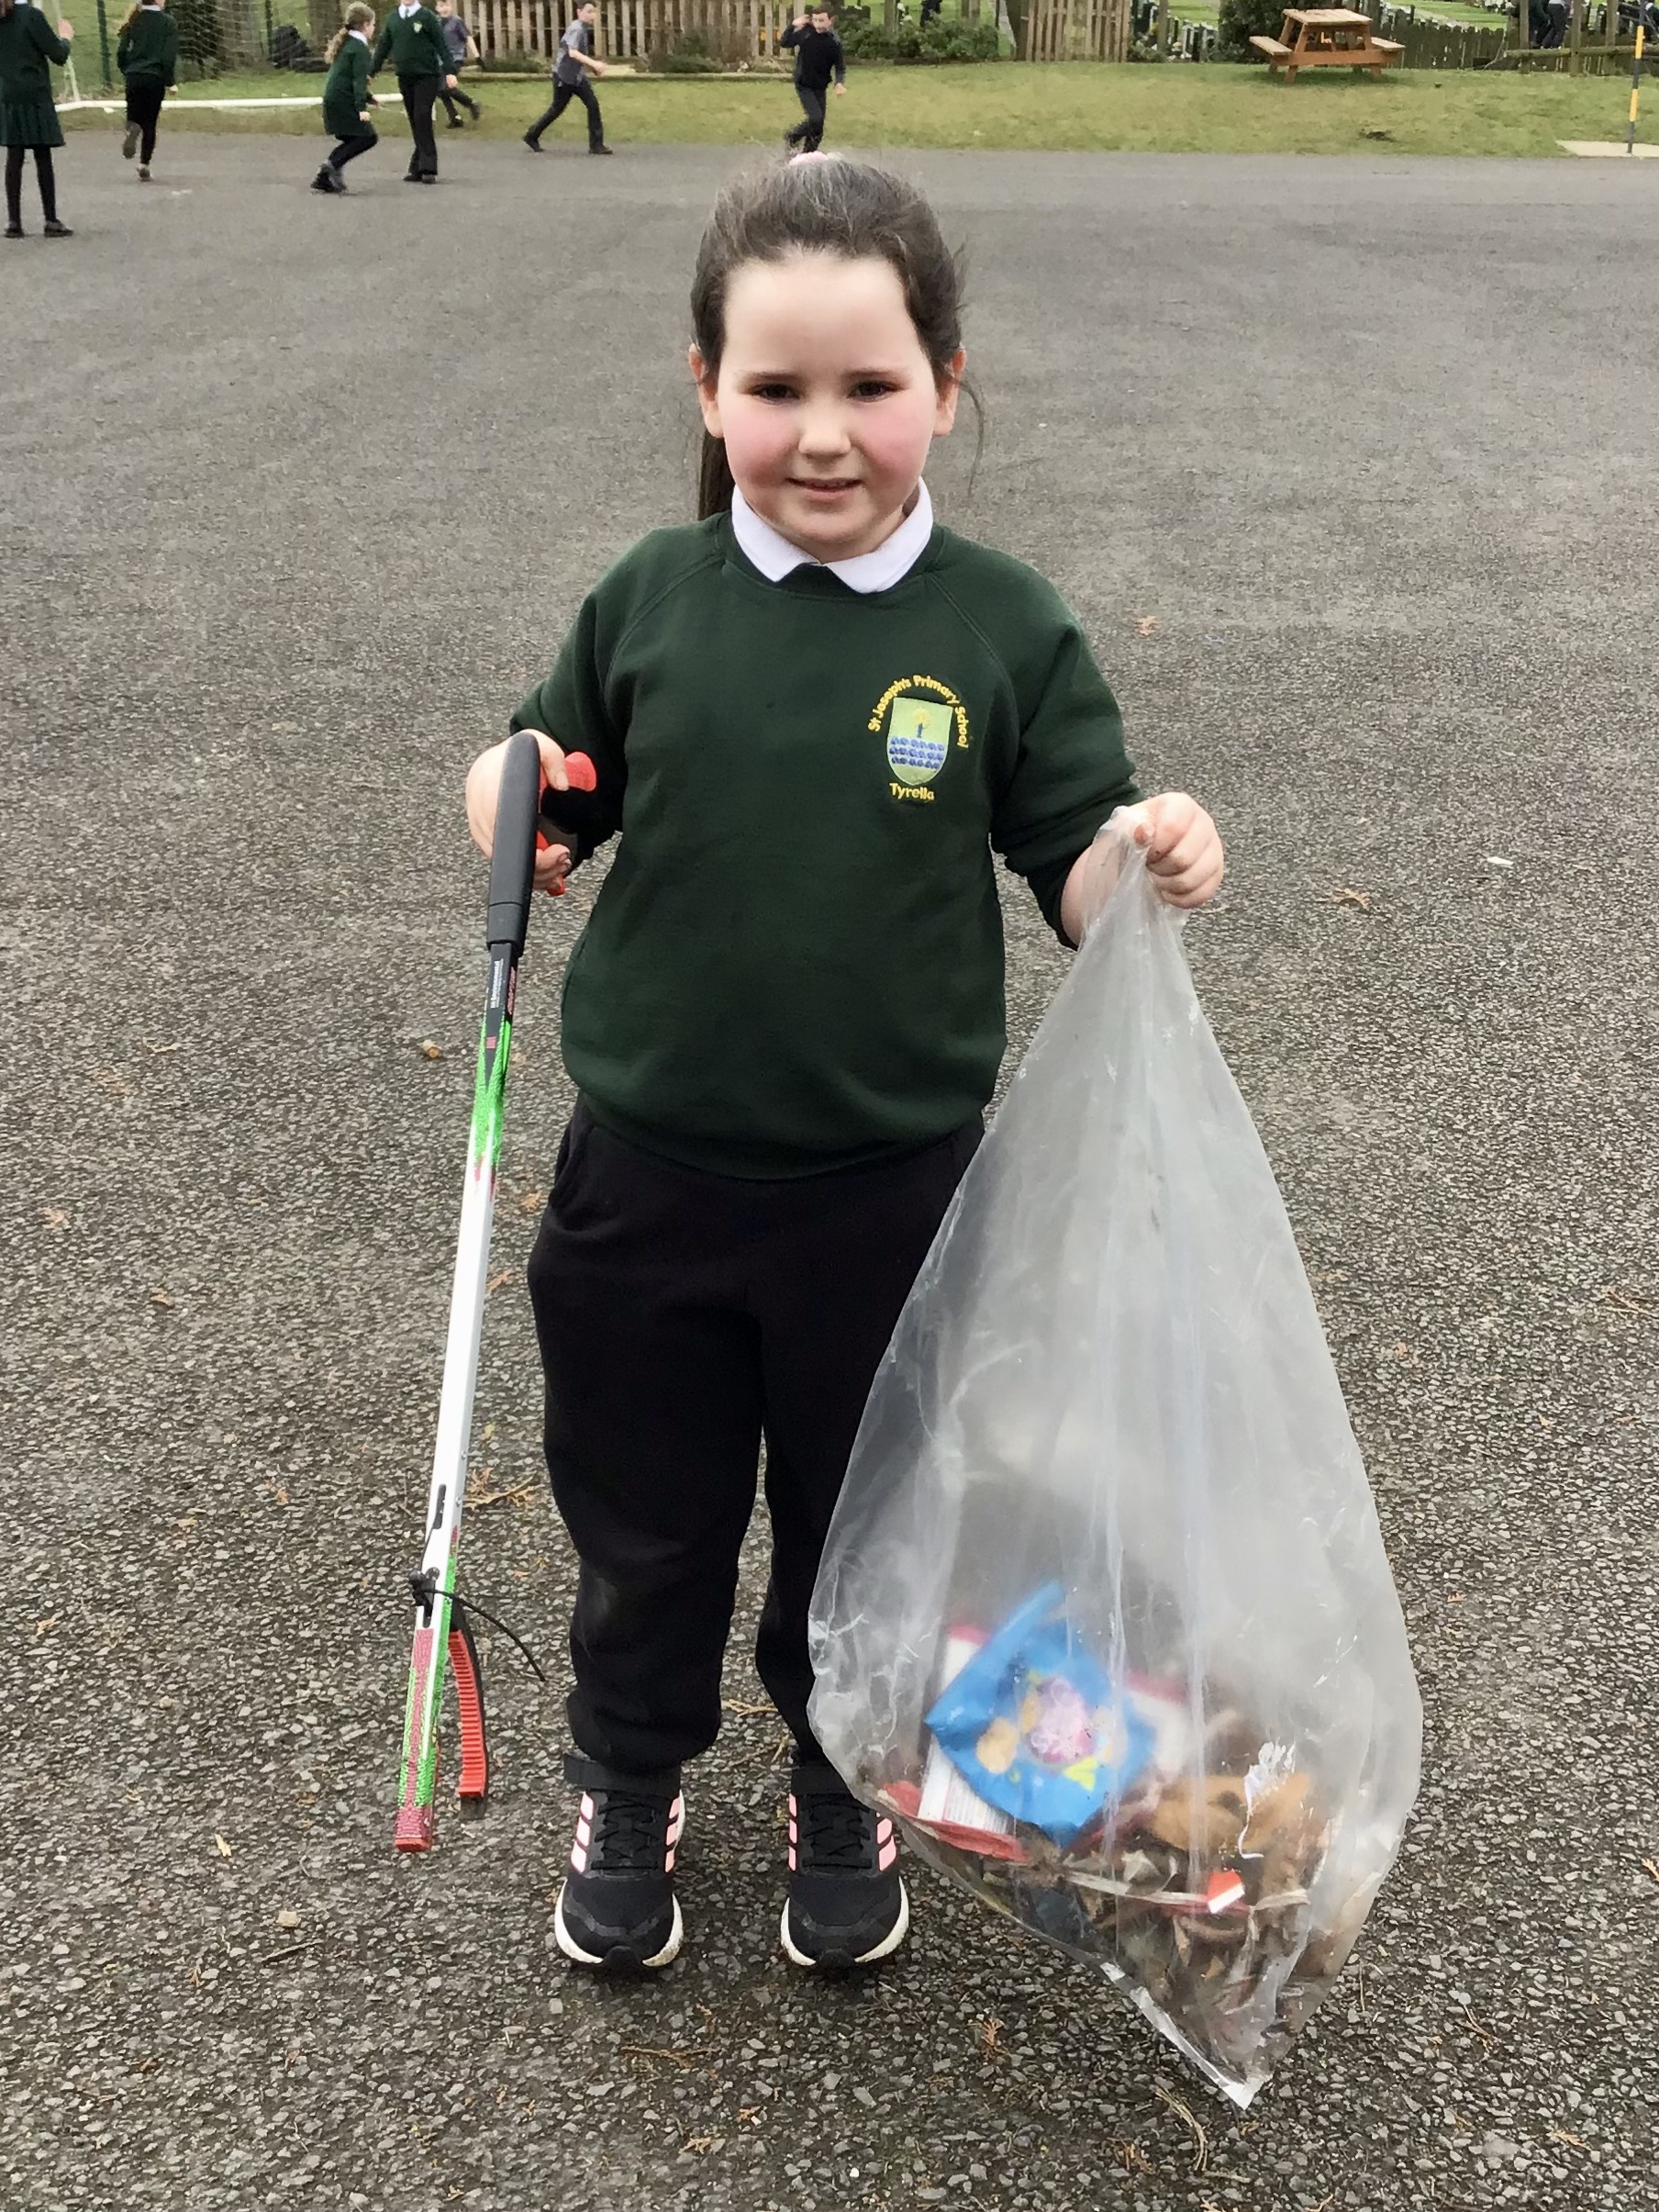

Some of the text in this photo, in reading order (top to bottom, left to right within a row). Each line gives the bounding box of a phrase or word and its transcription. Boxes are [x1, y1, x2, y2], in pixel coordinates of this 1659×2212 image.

[867, 717, 882, 732] St
[912, 674, 961, 704] Primary
[954, 706, 970, 749] School
[888, 782, 935, 801] Tyrella
